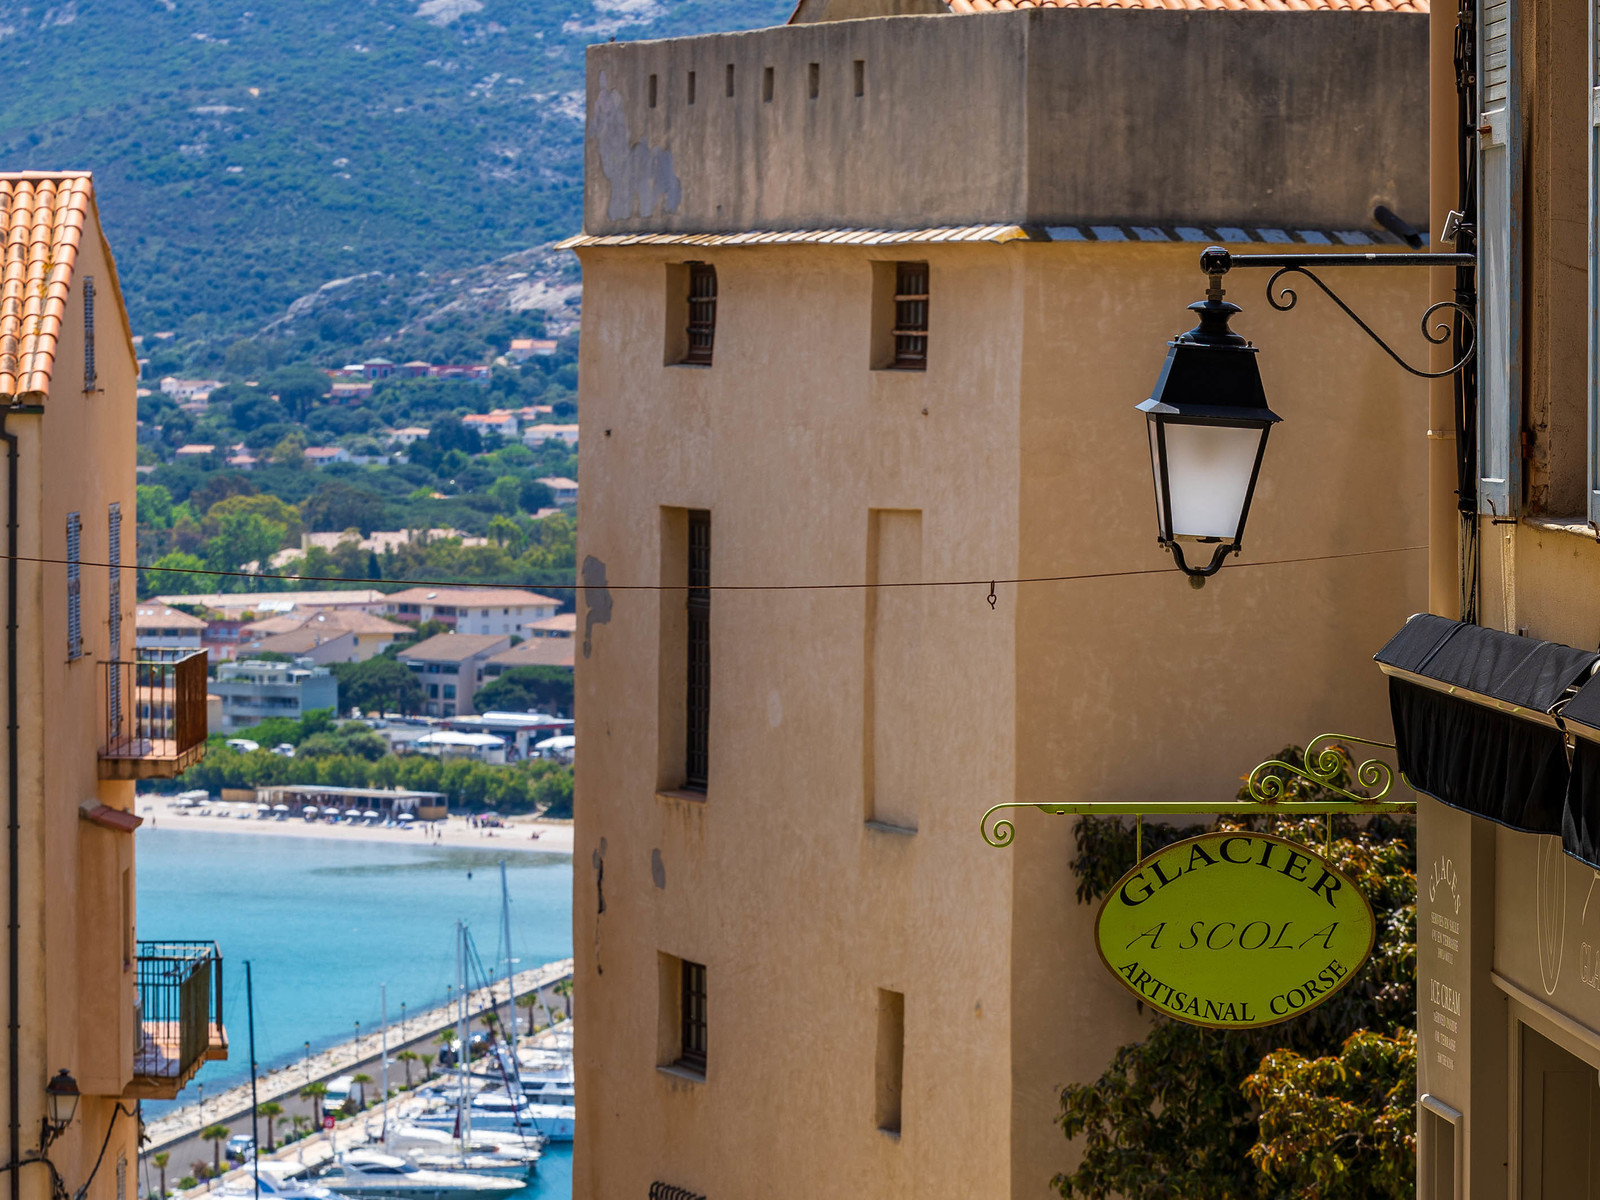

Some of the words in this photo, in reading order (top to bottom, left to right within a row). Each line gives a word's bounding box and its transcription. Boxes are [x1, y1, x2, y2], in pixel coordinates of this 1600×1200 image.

[1119, 837, 1343, 909] GLACIER
[1428, 855, 1462, 915] GLACES
[1126, 921, 1168, 950] A
[1178, 920, 1340, 950] SCOLA
[1118, 961, 1256, 1022] ARTISANAL
[1269, 959, 1348, 1016] CORSE
[1430, 978, 1440, 1005] ICE
[1441, 984, 1461, 1017] CREAM
